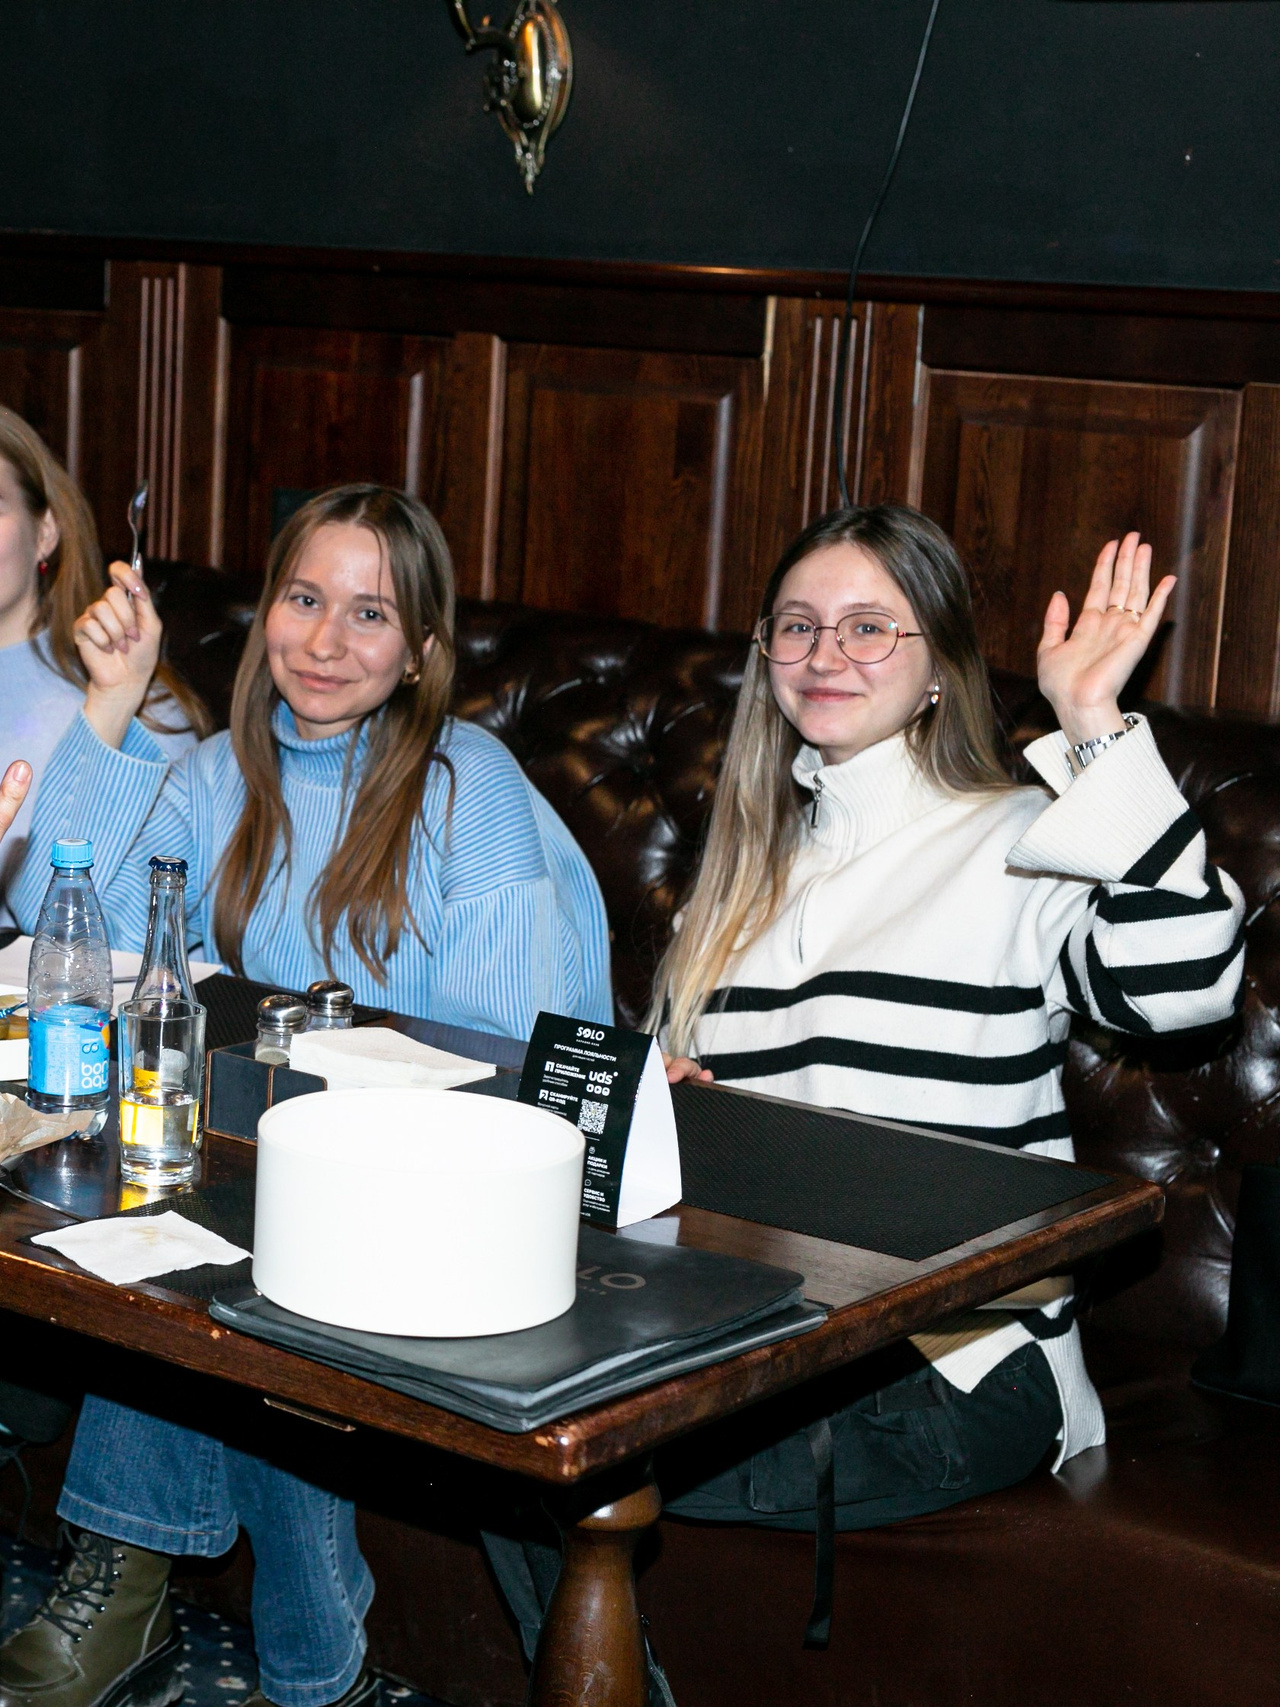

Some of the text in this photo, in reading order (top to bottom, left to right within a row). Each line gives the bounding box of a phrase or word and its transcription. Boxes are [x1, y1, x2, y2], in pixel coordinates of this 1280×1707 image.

[576, 1026, 605, 1042] SOLO
[554, 1043, 583, 1054] ПРОГРАММА
[583, 1050, 617, 1062] ЛОЯЛЬНОСТИ
[81, 1061, 108, 1076] bon
[554, 1068, 587, 1080] ПРИЛОЖЕНИЕ
[555, 1062, 580, 1072] СКАЧАЙТЕ
[81, 1074, 108, 1089] aqu
[588, 1069, 613, 1085] uds
[576, 1264, 647, 1290] LO
